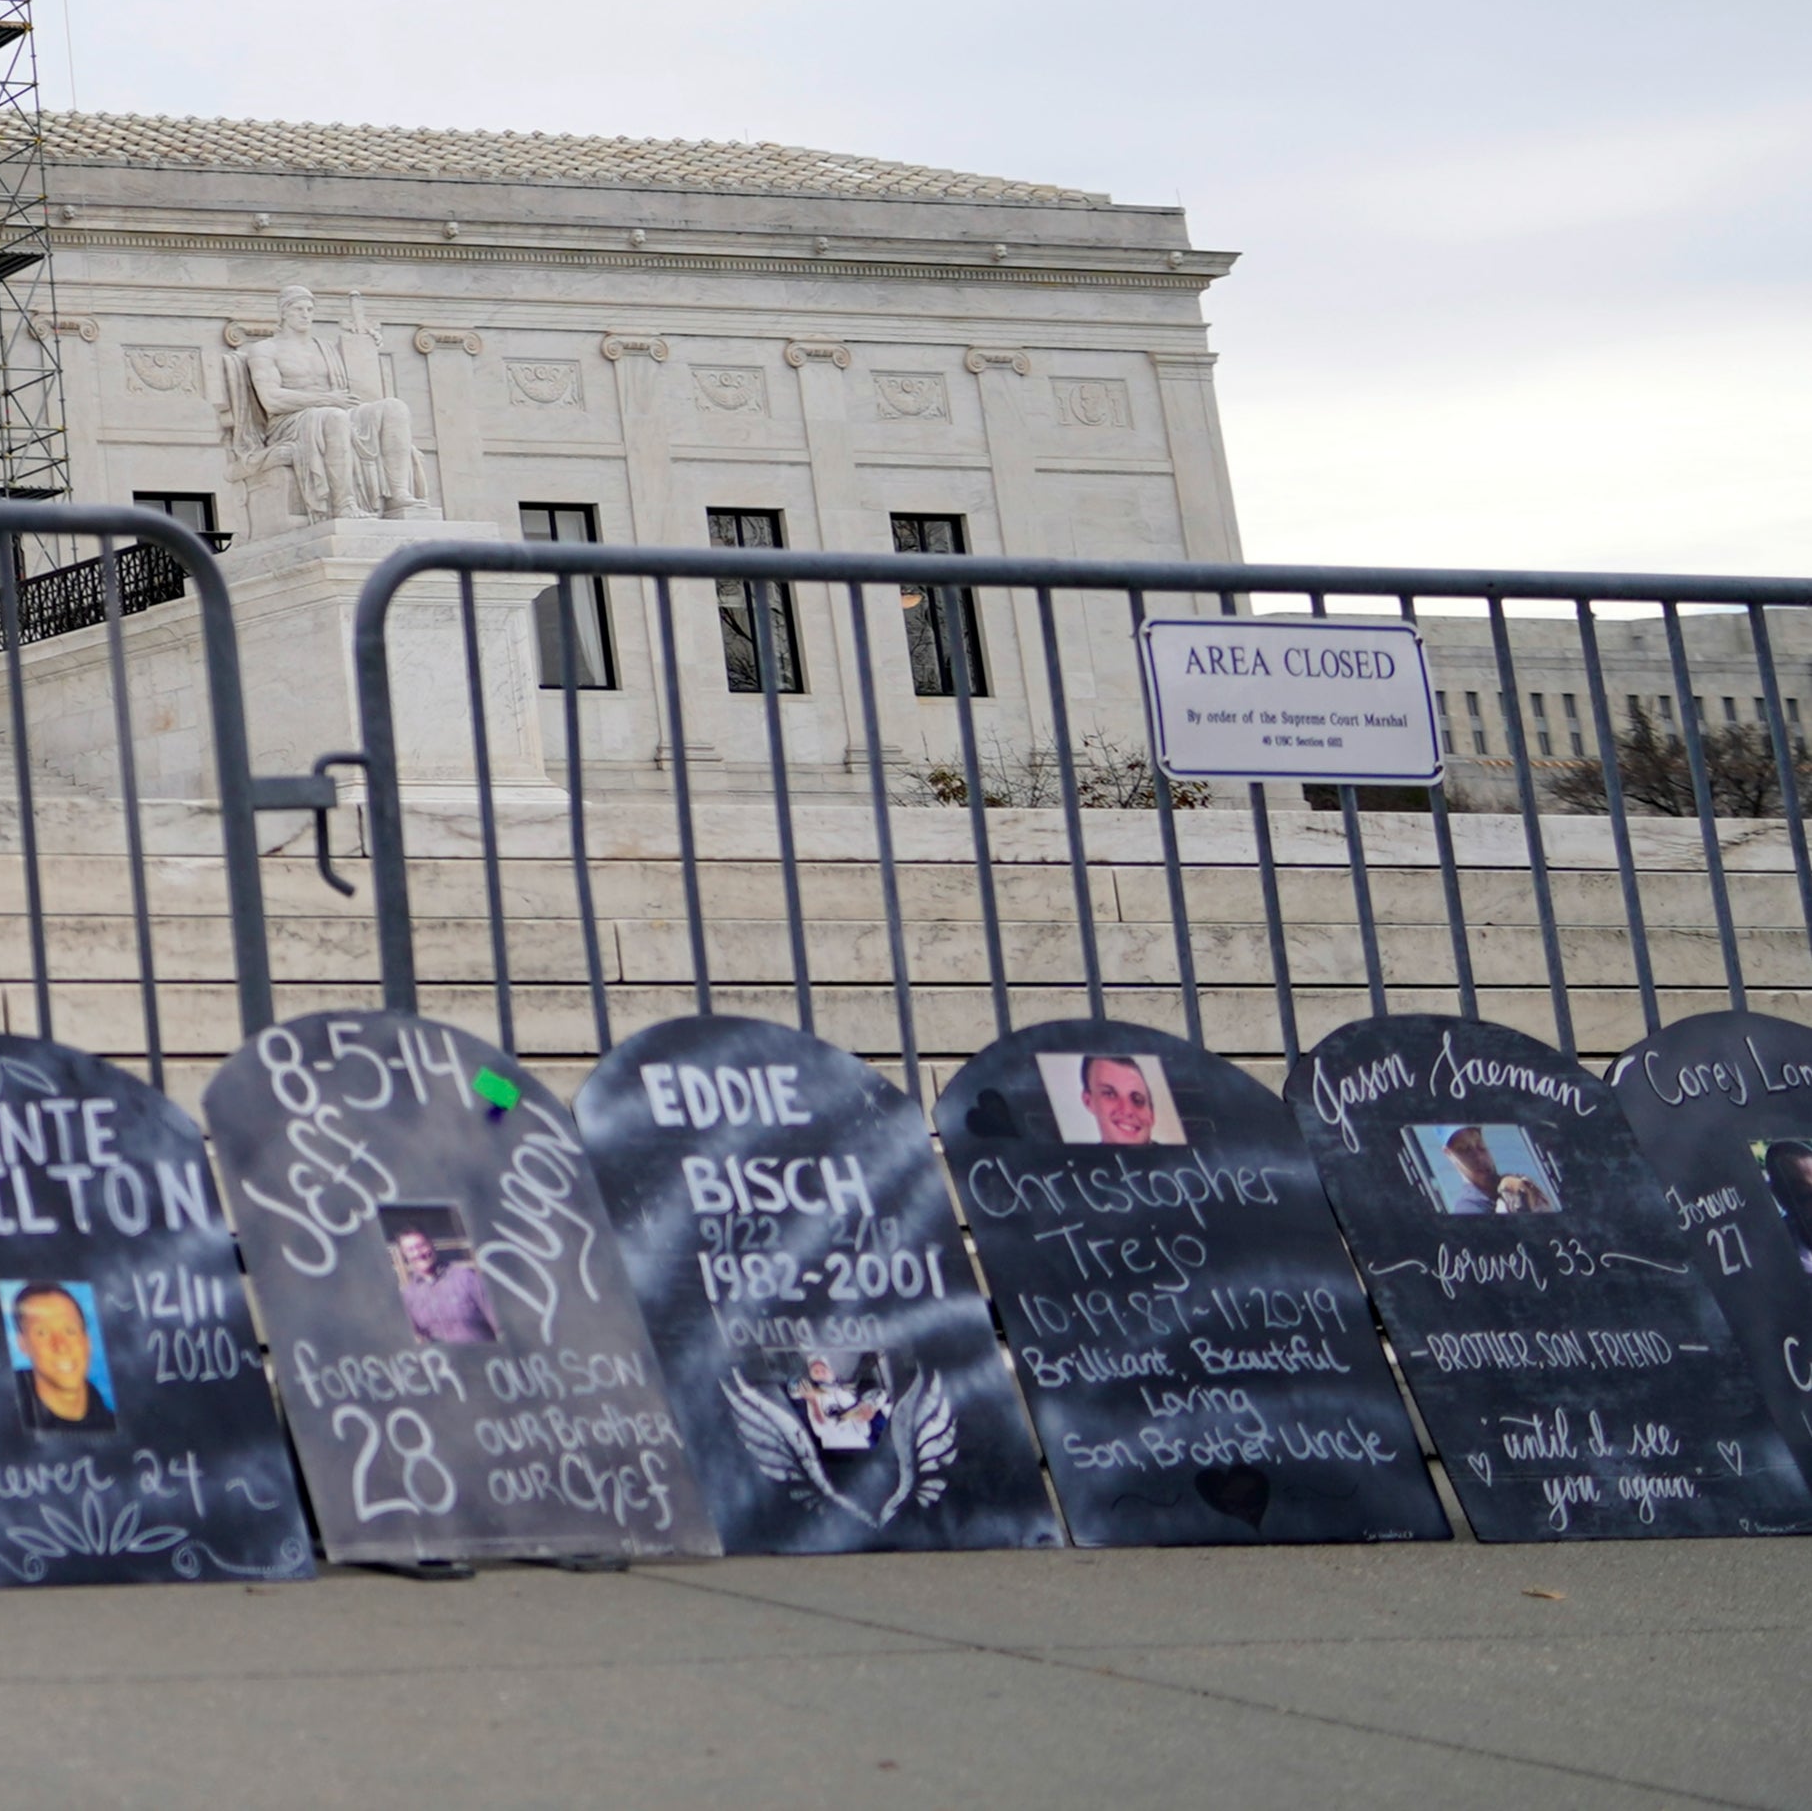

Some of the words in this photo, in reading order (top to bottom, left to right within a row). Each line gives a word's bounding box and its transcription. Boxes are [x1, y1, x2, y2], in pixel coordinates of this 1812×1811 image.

[1186, 645, 1272, 676] AREA
[1284, 647, 1395, 680] CLOSED
[1187, 709, 1201, 725] By
[1207, 709, 1237, 724] order
[1242, 709, 1255, 724] of
[1260, 710, 1276, 724] the
[1281, 710, 1325, 727] Supreme
[1329, 712, 1359, 727] Court
[1365, 713, 1408, 728] Marshal
[258, 1021, 473, 1115] 8-5-14
[1643, 1051, 1748, 1107] Corey
[639, 1063, 813, 1130] EDDIE
[1313, 1051, 1417, 1154] Jason
[681, 1154, 874, 1216] BISCH
[967, 1148, 1296, 1229] Christopher
[1665, 1184, 1746, 1232] Forever
[699, 1213, 781, 1255] 9/22
[1033, 1222, 1207, 1292] Trejo
[1707, 1223, 1753, 1276] 27
[1431, 1241, 1547, 1301] forever
[1549, 1237, 1596, 1277] 33
[712, 1304, 816, 1353] loving
[827, 1312, 884, 1346] son
[1593, 1330, 1673, 1368] FRIEND
[485, 1353, 564, 1403] OUR
[567, 1350, 647, 1400] SON
[1190, 1336, 1352, 1376] Beautiful
[475, 1411, 555, 1458] OUR
[1141, 1385, 1269, 1437] Loving
[332, 1403, 459, 1524] 28
[1062, 1433, 1146, 1471] Son,
[1140, 1427, 1282, 1468] Brother,
[1279, 1422, 1398, 1463] Uncle
[1626, 1421, 1680, 1458] see
[134, 1449, 206, 1518] 24
[487, 1465, 565, 1507] OUR
[1543, 1475, 1601, 1532] you
